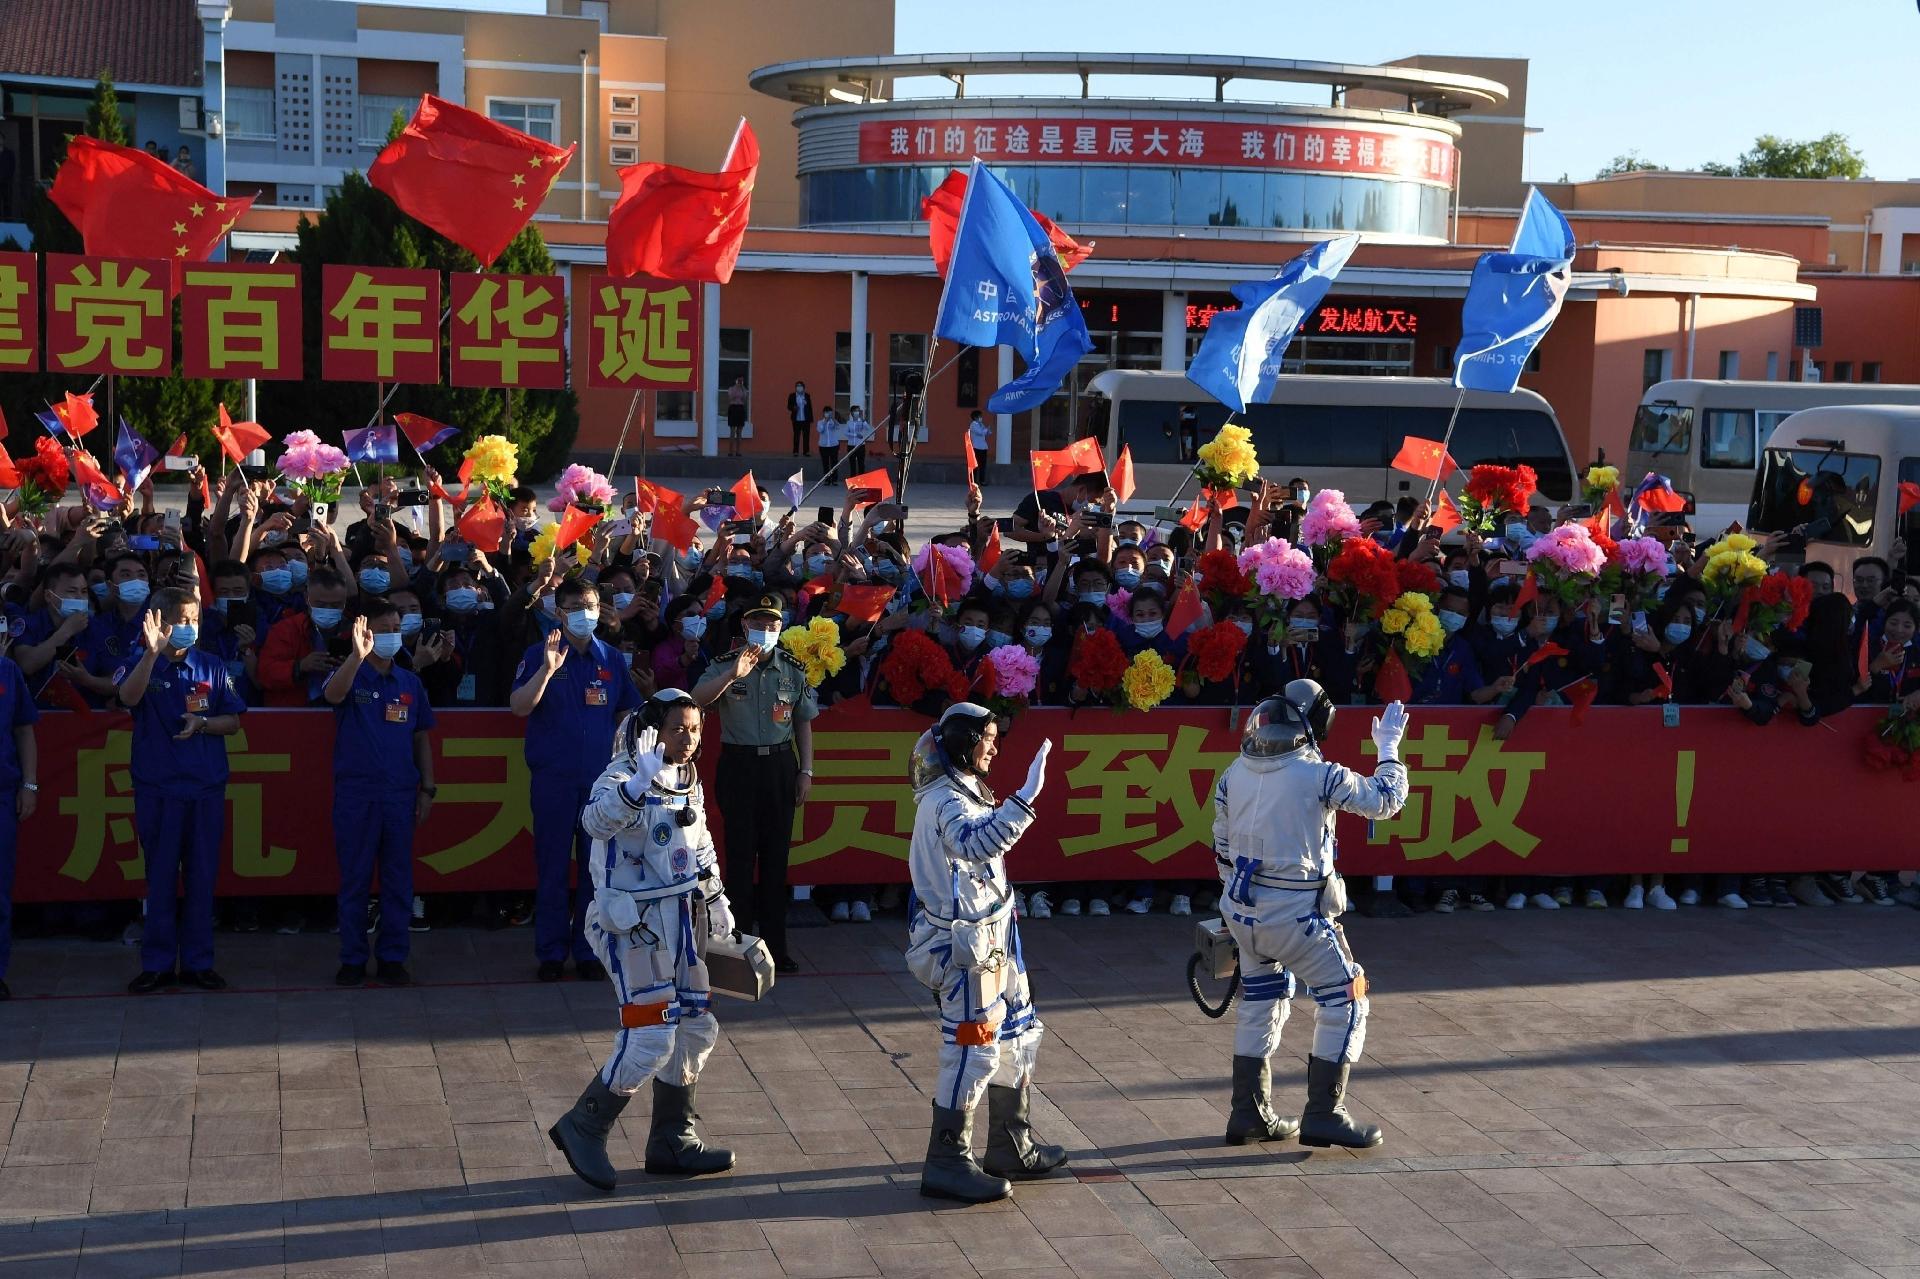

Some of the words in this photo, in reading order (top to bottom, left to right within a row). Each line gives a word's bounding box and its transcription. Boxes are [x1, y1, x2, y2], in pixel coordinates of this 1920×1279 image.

[890, 125, 1205, 158] 我们的征途是星辰大海
